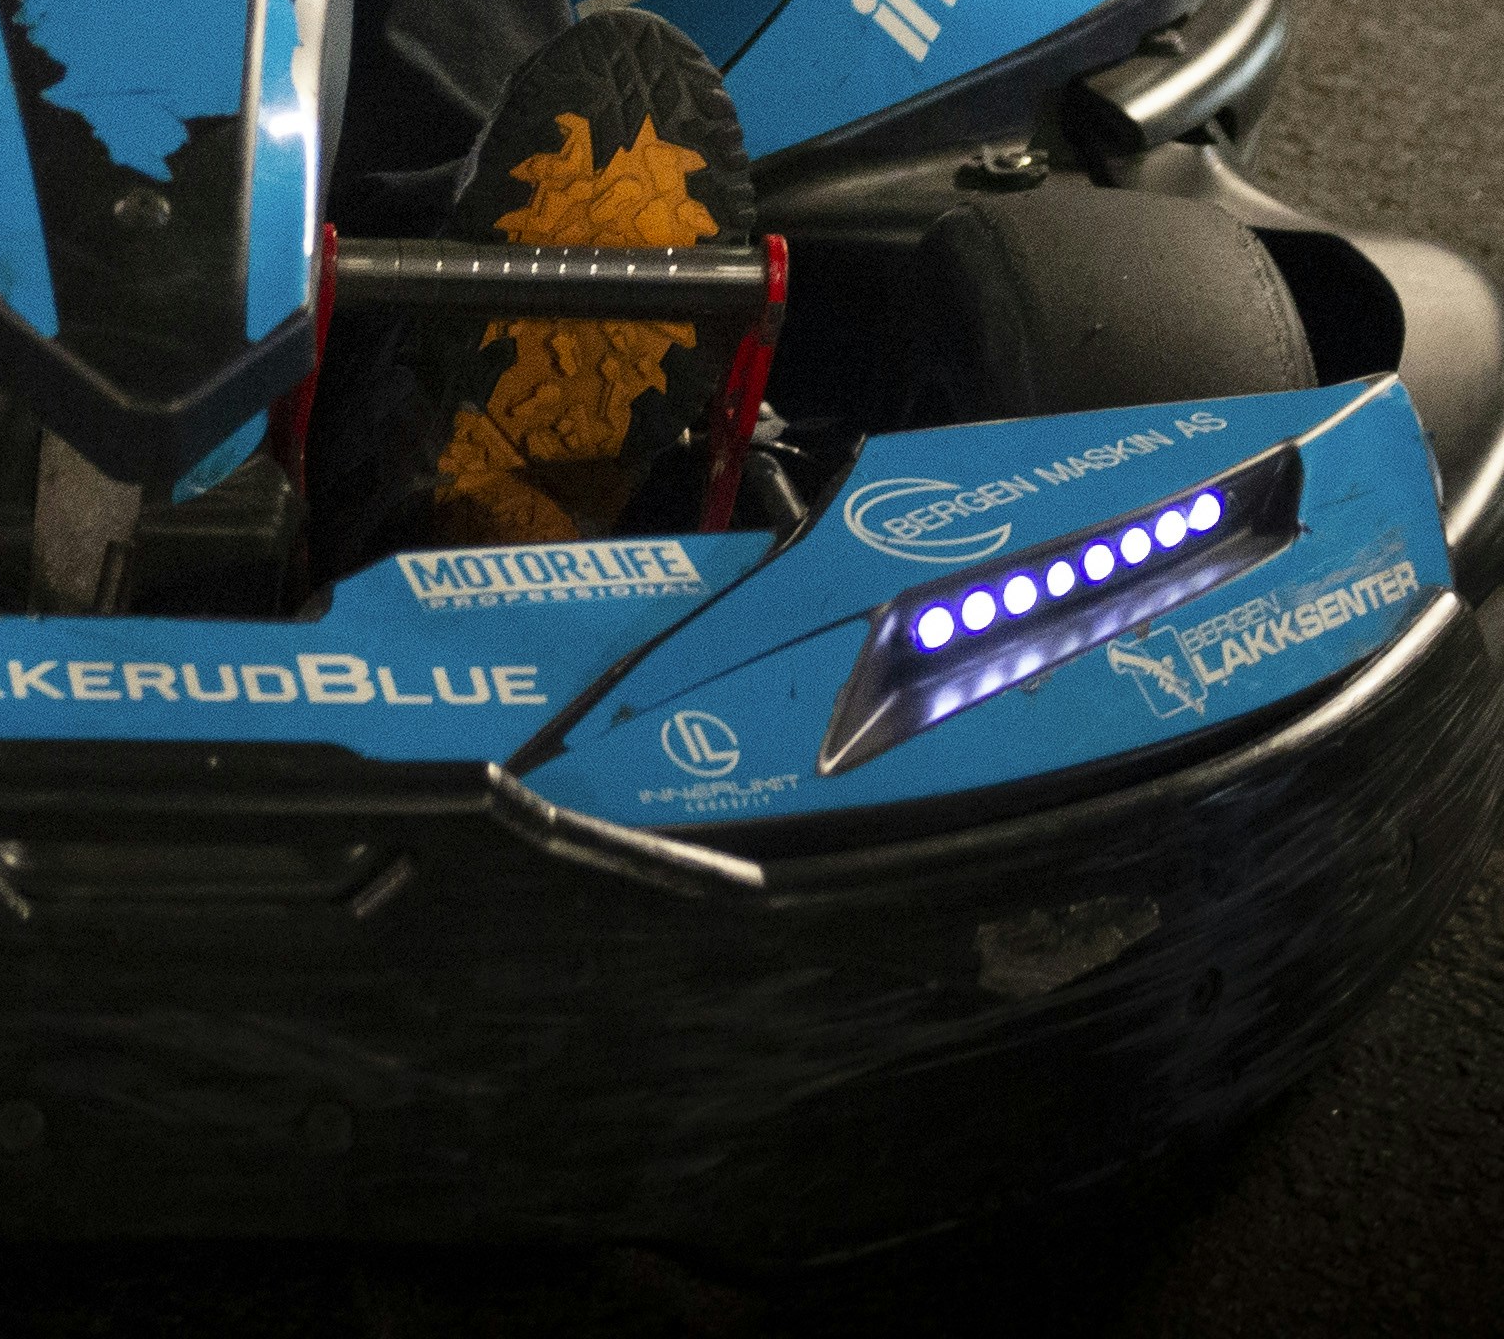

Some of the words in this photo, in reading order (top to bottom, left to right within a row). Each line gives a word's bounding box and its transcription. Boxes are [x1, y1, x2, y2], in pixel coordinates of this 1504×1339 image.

[883, 475, 1038, 543] BERGEN
[1034, 429, 1175, 486] MASKIN
[1174, 410, 1228, 440] AS
[1181, 590, 1282, 651] BERGEN
[1194, 562, 1422, 683] LAKKSENTER
